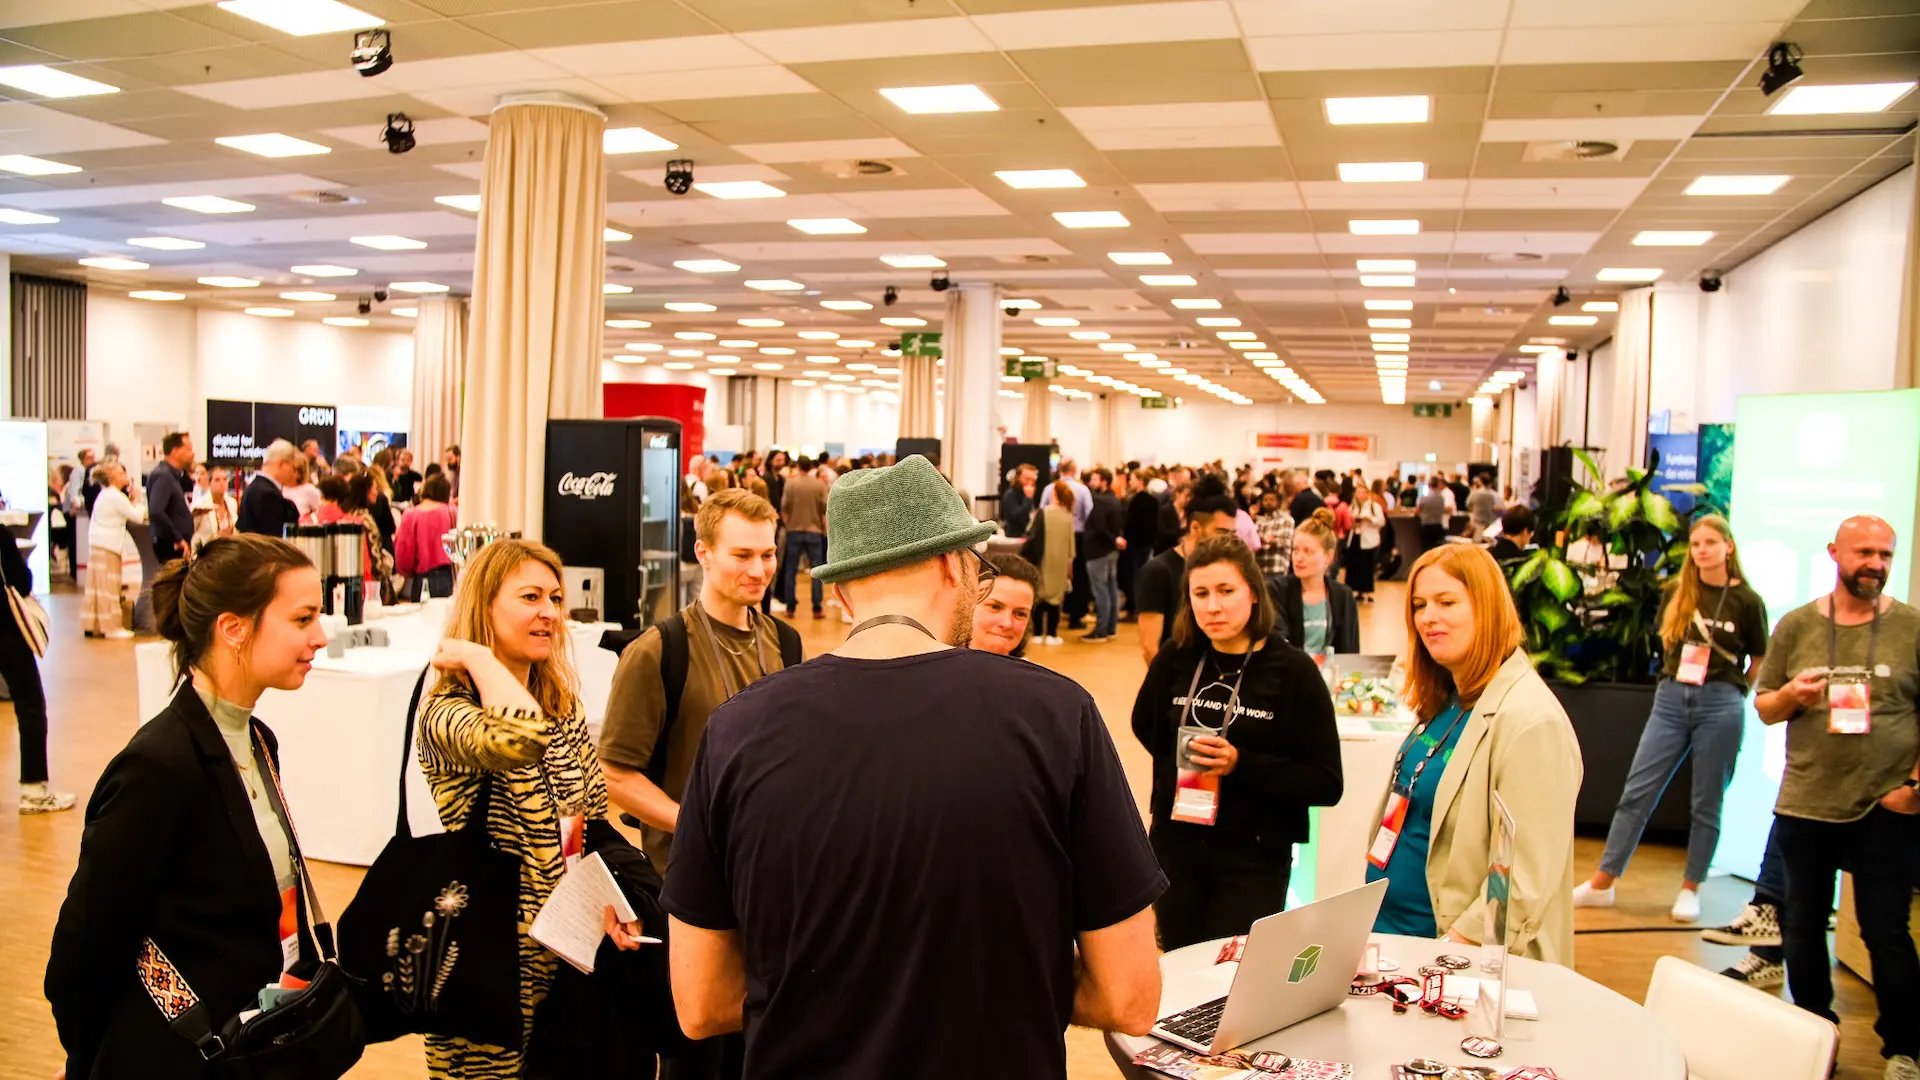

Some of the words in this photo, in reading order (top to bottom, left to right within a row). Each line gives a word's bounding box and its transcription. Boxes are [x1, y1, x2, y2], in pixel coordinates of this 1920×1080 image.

[298, 407, 335, 426] GRÜN
[212, 433, 240, 448] digital
[241, 433, 253, 447] for
[212, 446, 239, 458] better
[558, 471, 618, 496] Coca-Cola
[1204, 701, 1222, 711] AND
[1223, 704, 1245, 715] YUR
